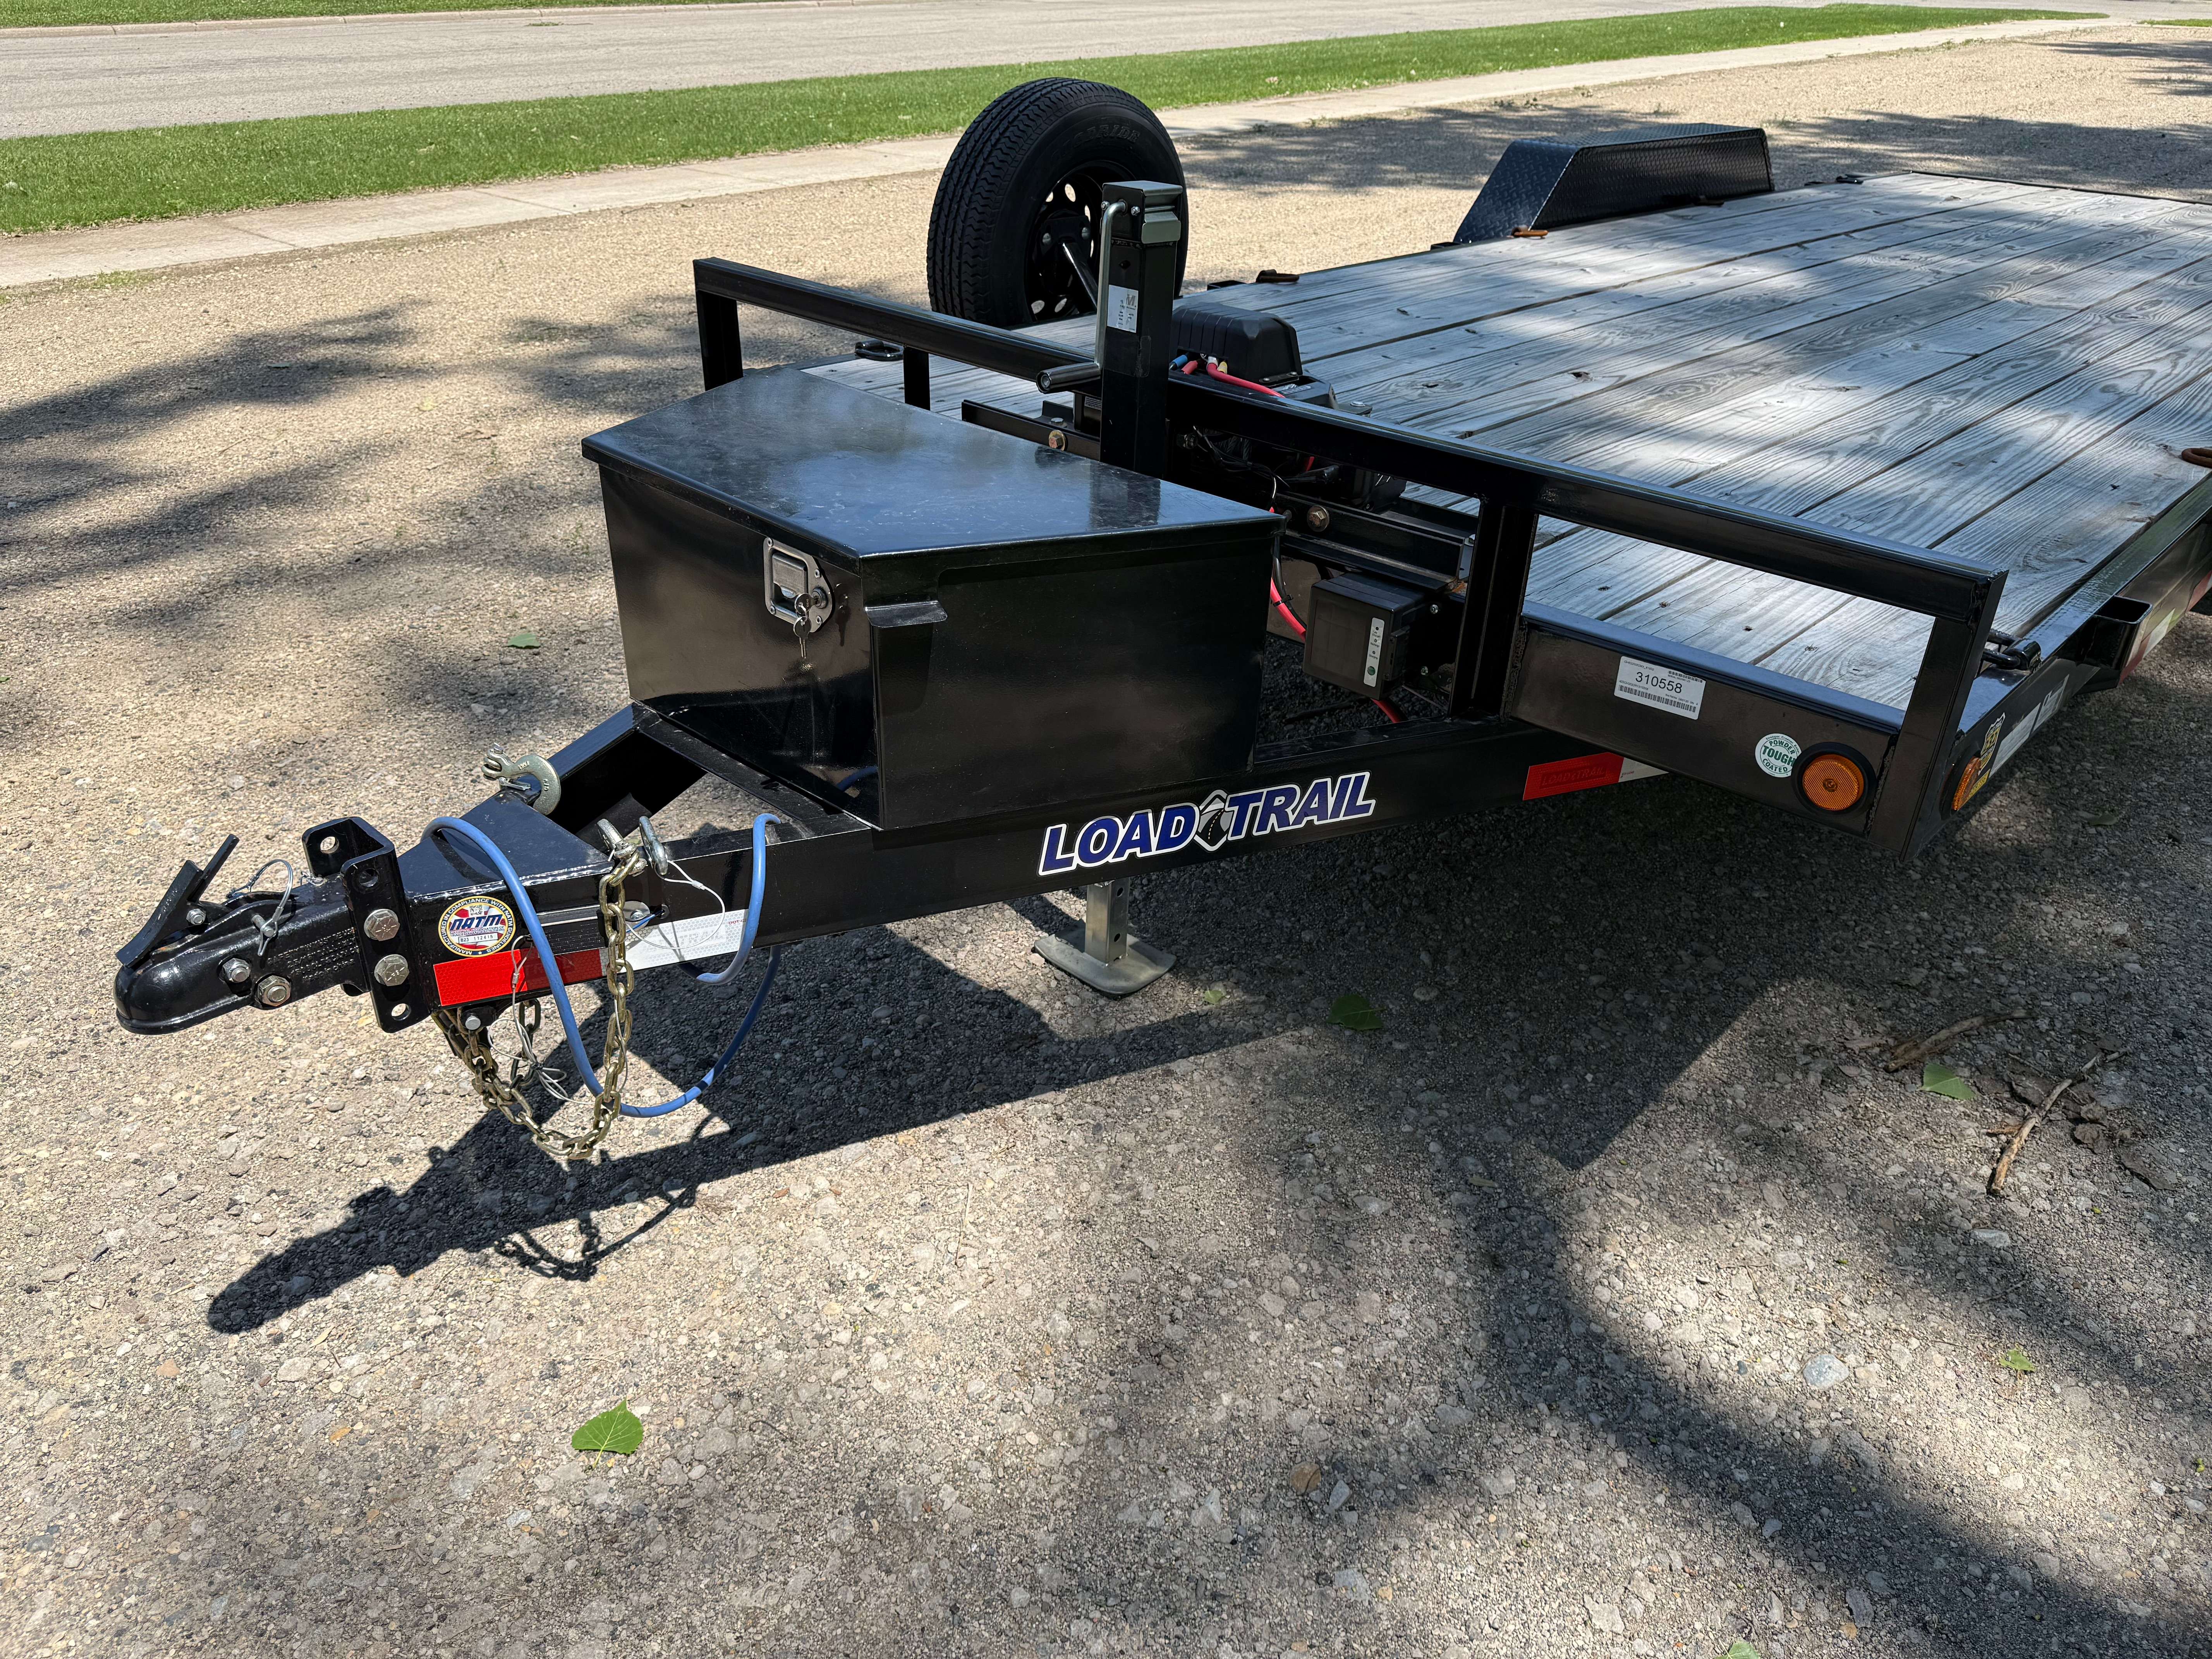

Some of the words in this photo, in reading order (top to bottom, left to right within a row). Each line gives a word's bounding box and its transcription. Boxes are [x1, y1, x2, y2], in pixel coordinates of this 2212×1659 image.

[1635, 672, 1682, 694] 310558
[1769, 740, 1795, 754] POWDER
[1762, 745, 1796, 767] TOUGH
[1763, 759, 1788, 772] COATED
[1037, 803, 1200, 876] LOAD
[1224, 771, 1376, 840] TRAIL
[448, 898, 489, 914] COMPLIANCE
[491, 900, 504, 910] WITH
[449, 914, 503, 931] NATM
[505, 910, 513, 926] NATM
[441, 922, 472, 955] MANUFACTURED
[486, 927, 513, 953] GUIDELINES
